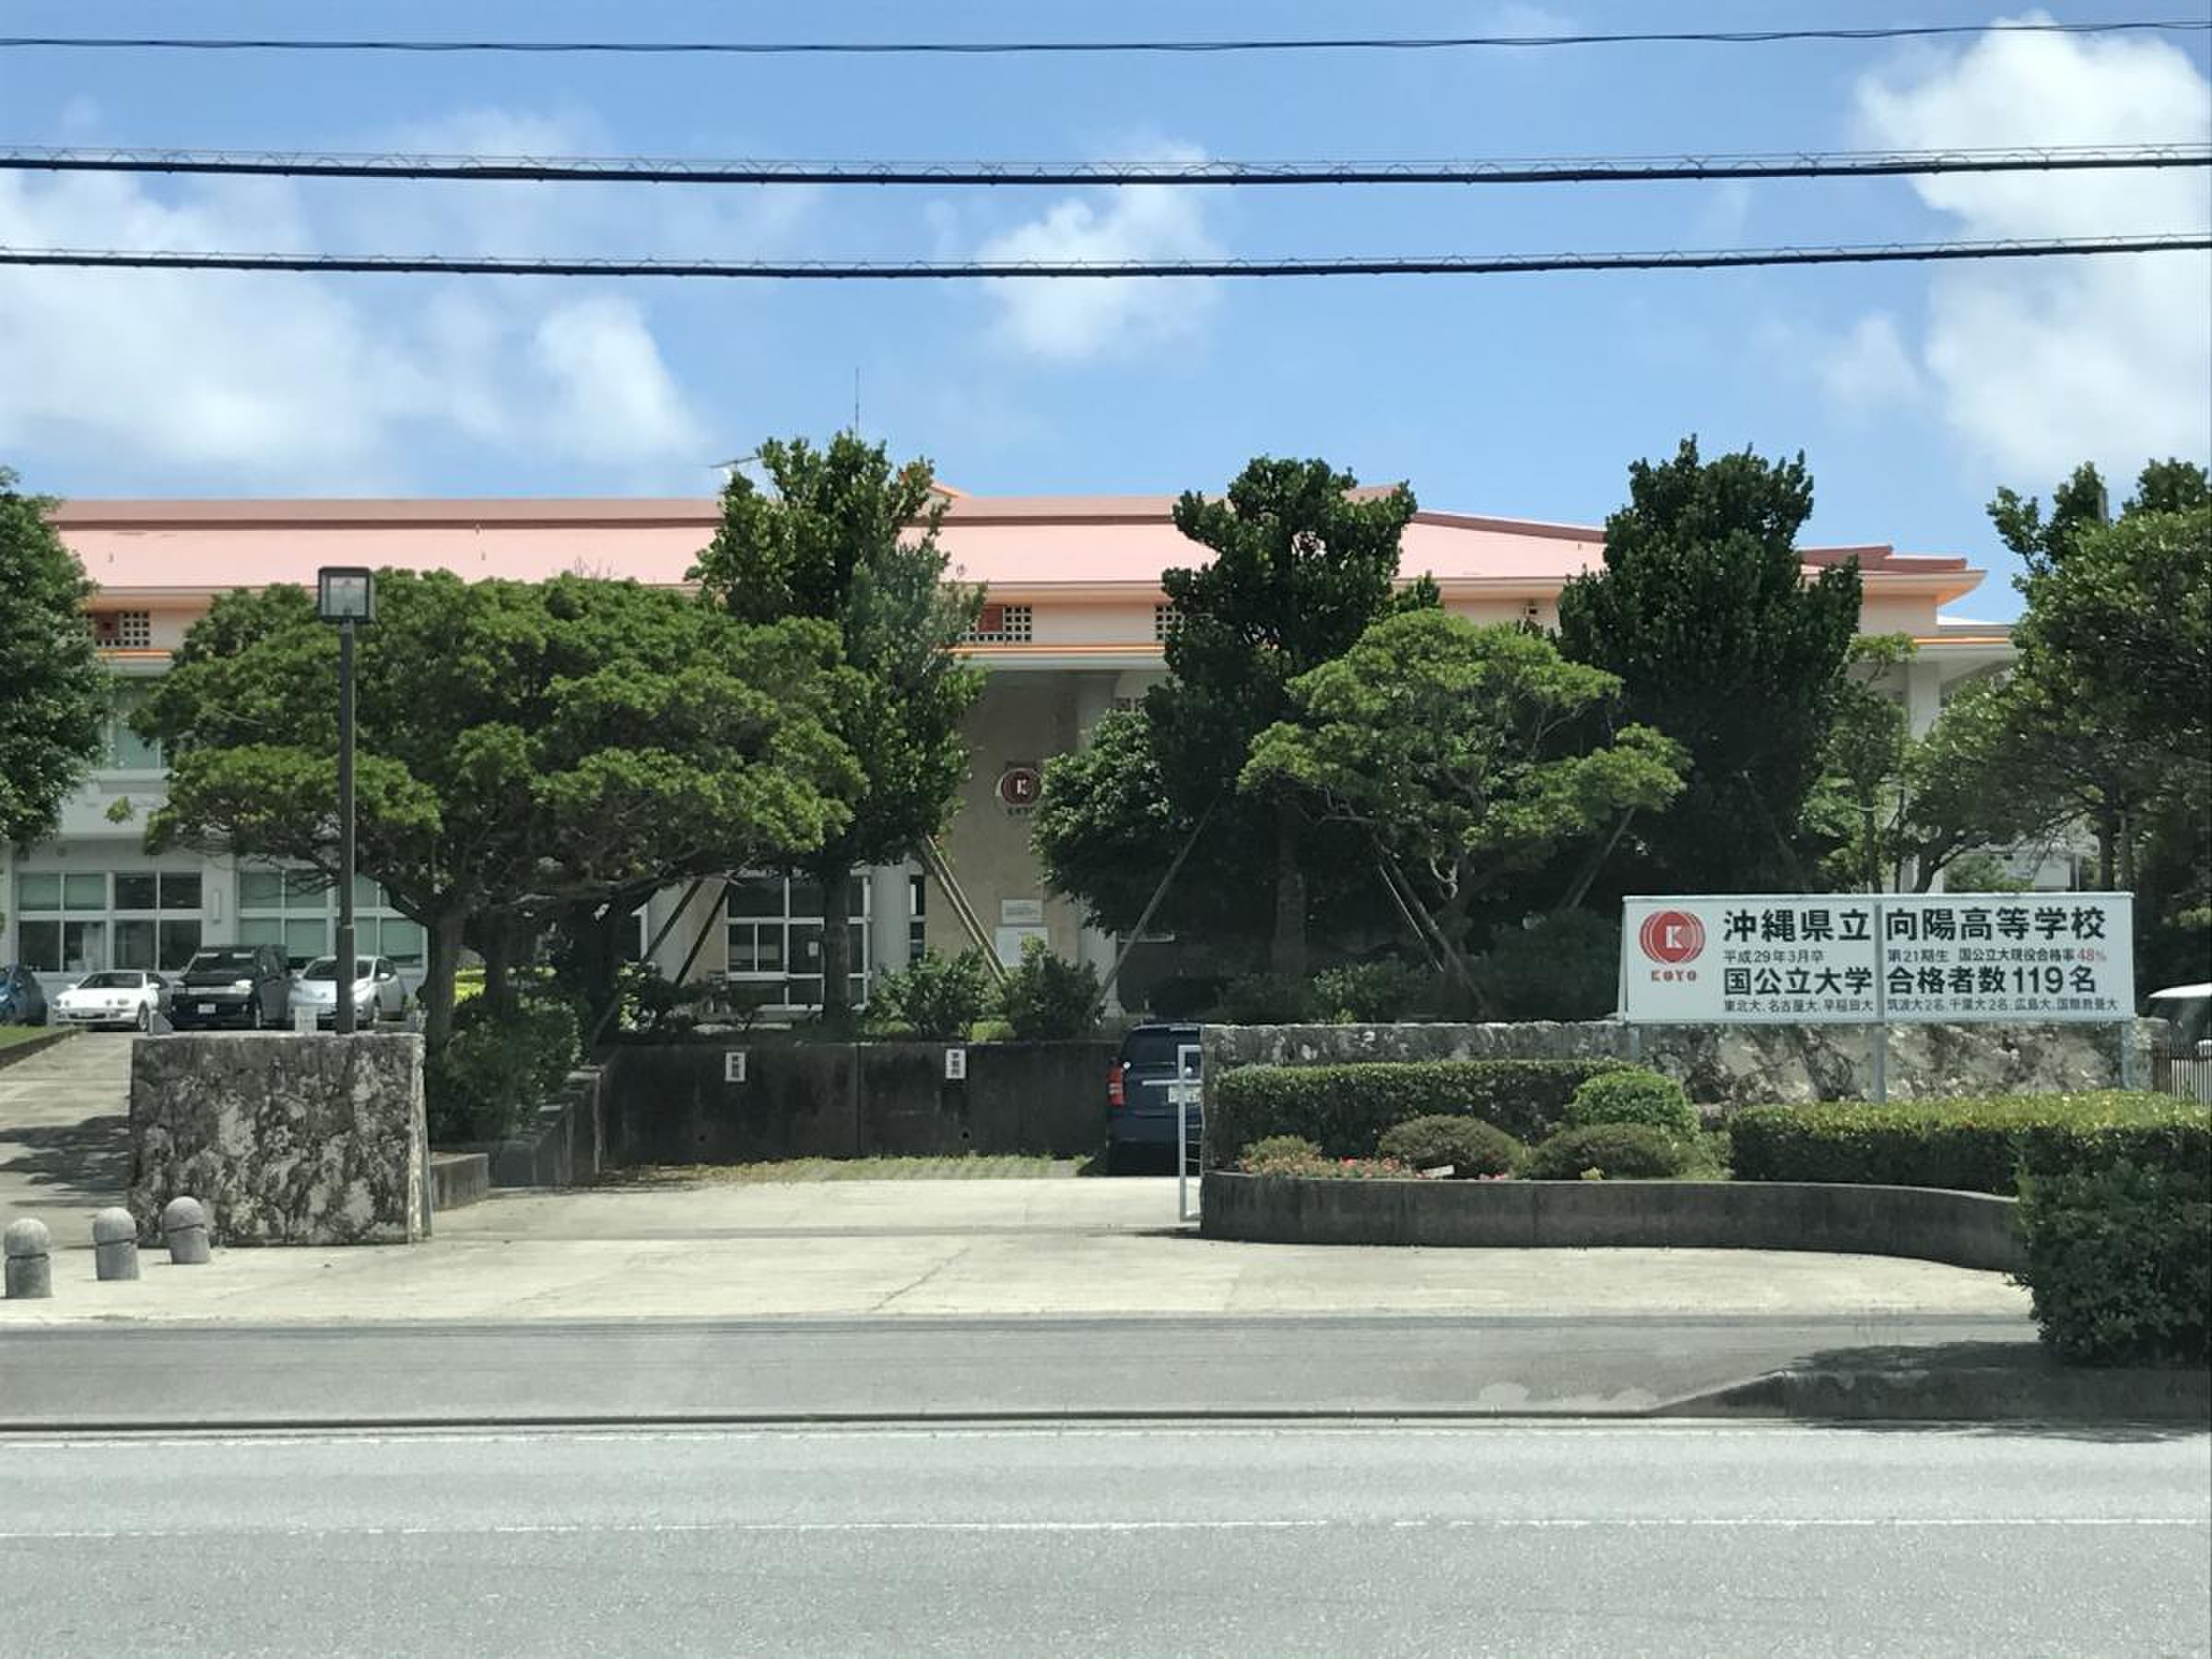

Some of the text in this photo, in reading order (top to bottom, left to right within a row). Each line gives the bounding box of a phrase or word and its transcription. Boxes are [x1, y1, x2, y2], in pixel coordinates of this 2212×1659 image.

[1665, 924, 1682, 949] K
[1724, 906, 2106, 943] 沖縄県立 向陽高等学校
[1724, 949, 1824, 963] 平成29年3月卒
[1888, 949, 1949, 963] 第21期生
[1652, 971, 1697, 982] KOYO
[1724, 965, 2096, 995] 国公立大学 合格者数119名
